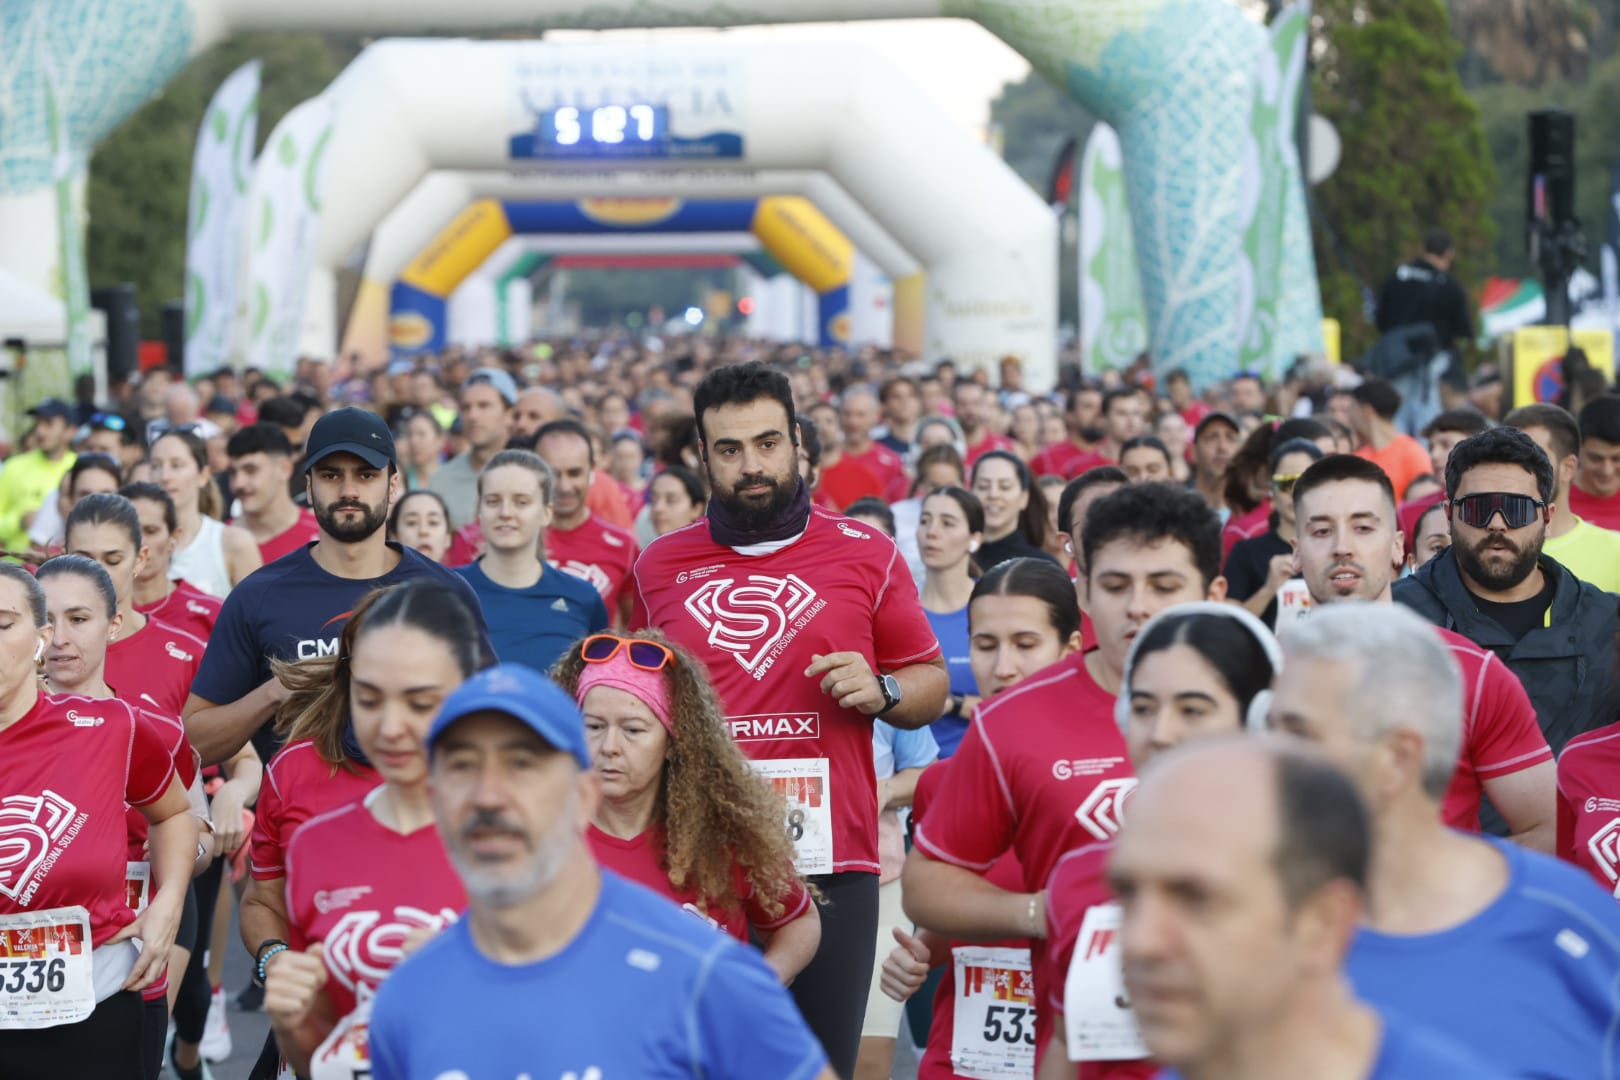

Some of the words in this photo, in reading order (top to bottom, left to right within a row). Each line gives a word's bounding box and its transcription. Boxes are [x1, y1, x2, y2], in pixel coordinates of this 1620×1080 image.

[297, 637, 339, 660] CM
[753, 651, 775, 681] SÚPER
[772, 630, 799, 660] PERSONA
[795, 598, 828, 630] SOLIDARIA
[34, 847, 64, 882] PERSONA
[58, 812, 89, 848] SOLIDARIA
[983, 1005, 1036, 1045] 533
